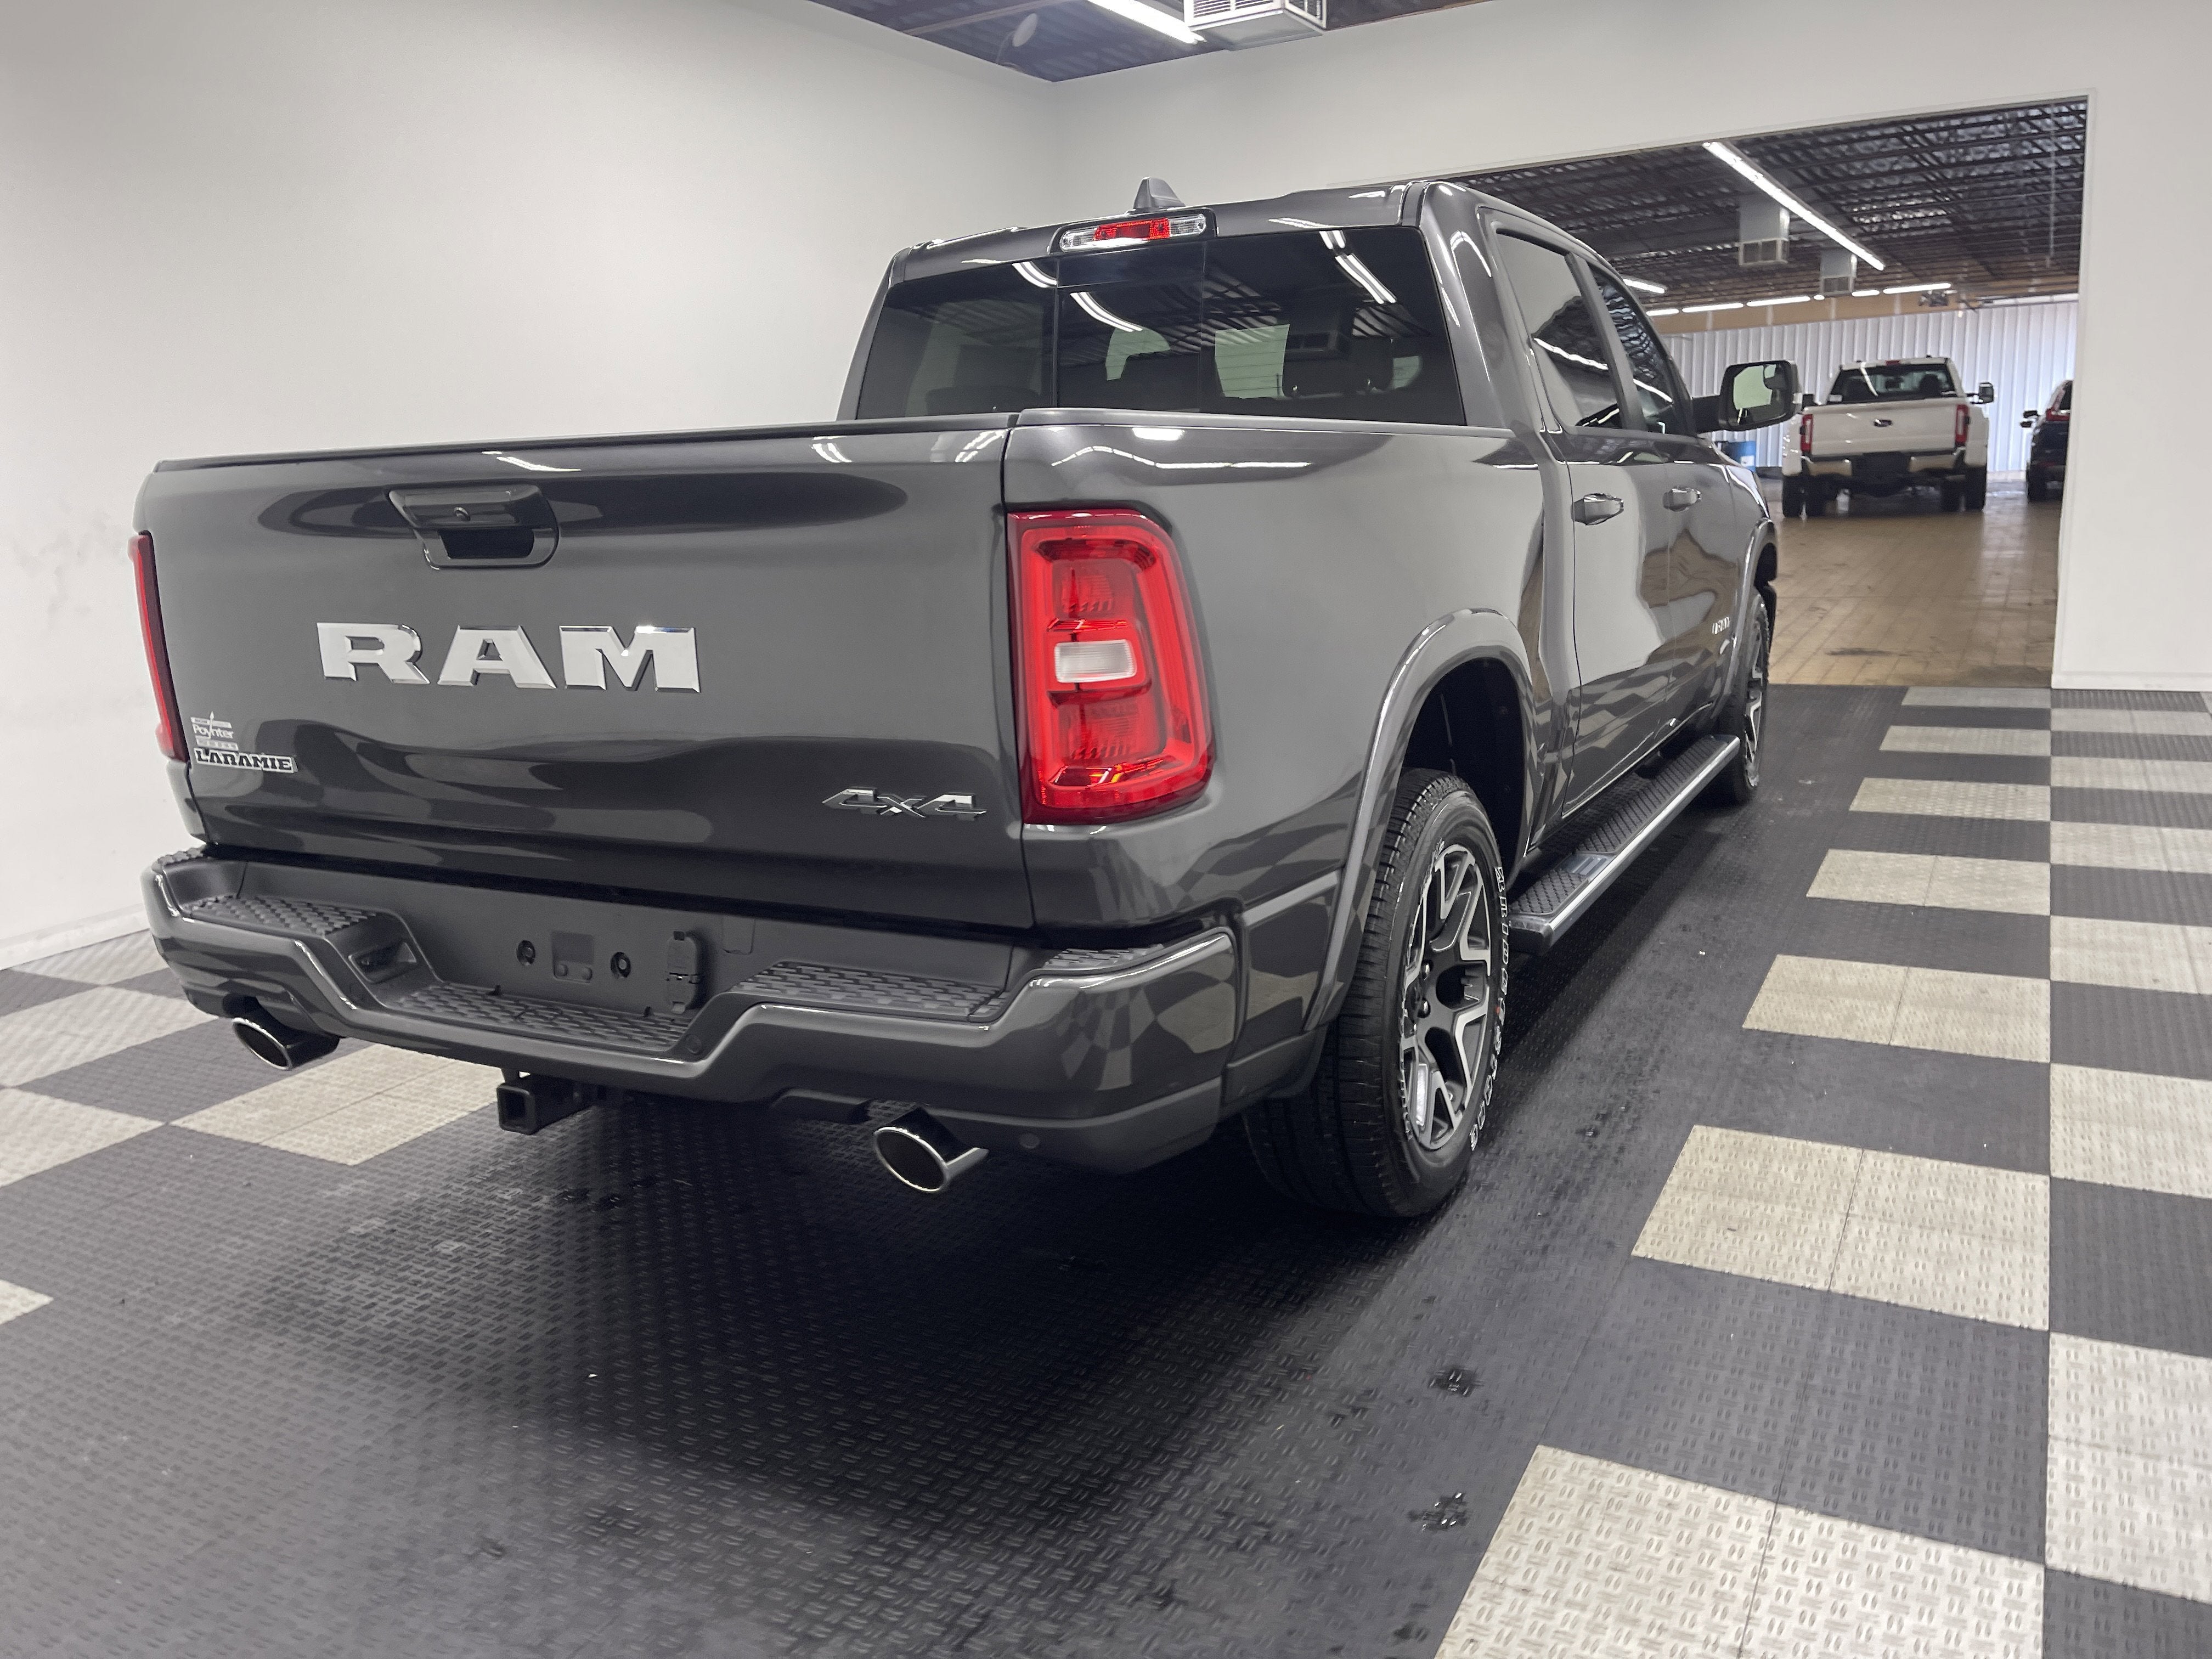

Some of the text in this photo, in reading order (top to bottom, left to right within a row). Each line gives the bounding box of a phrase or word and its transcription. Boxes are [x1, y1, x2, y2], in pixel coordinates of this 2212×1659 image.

[317, 622, 701, 693] RAM
[193, 723, 234, 740] Poynter
[194, 747, 297, 774] LARAMIE
